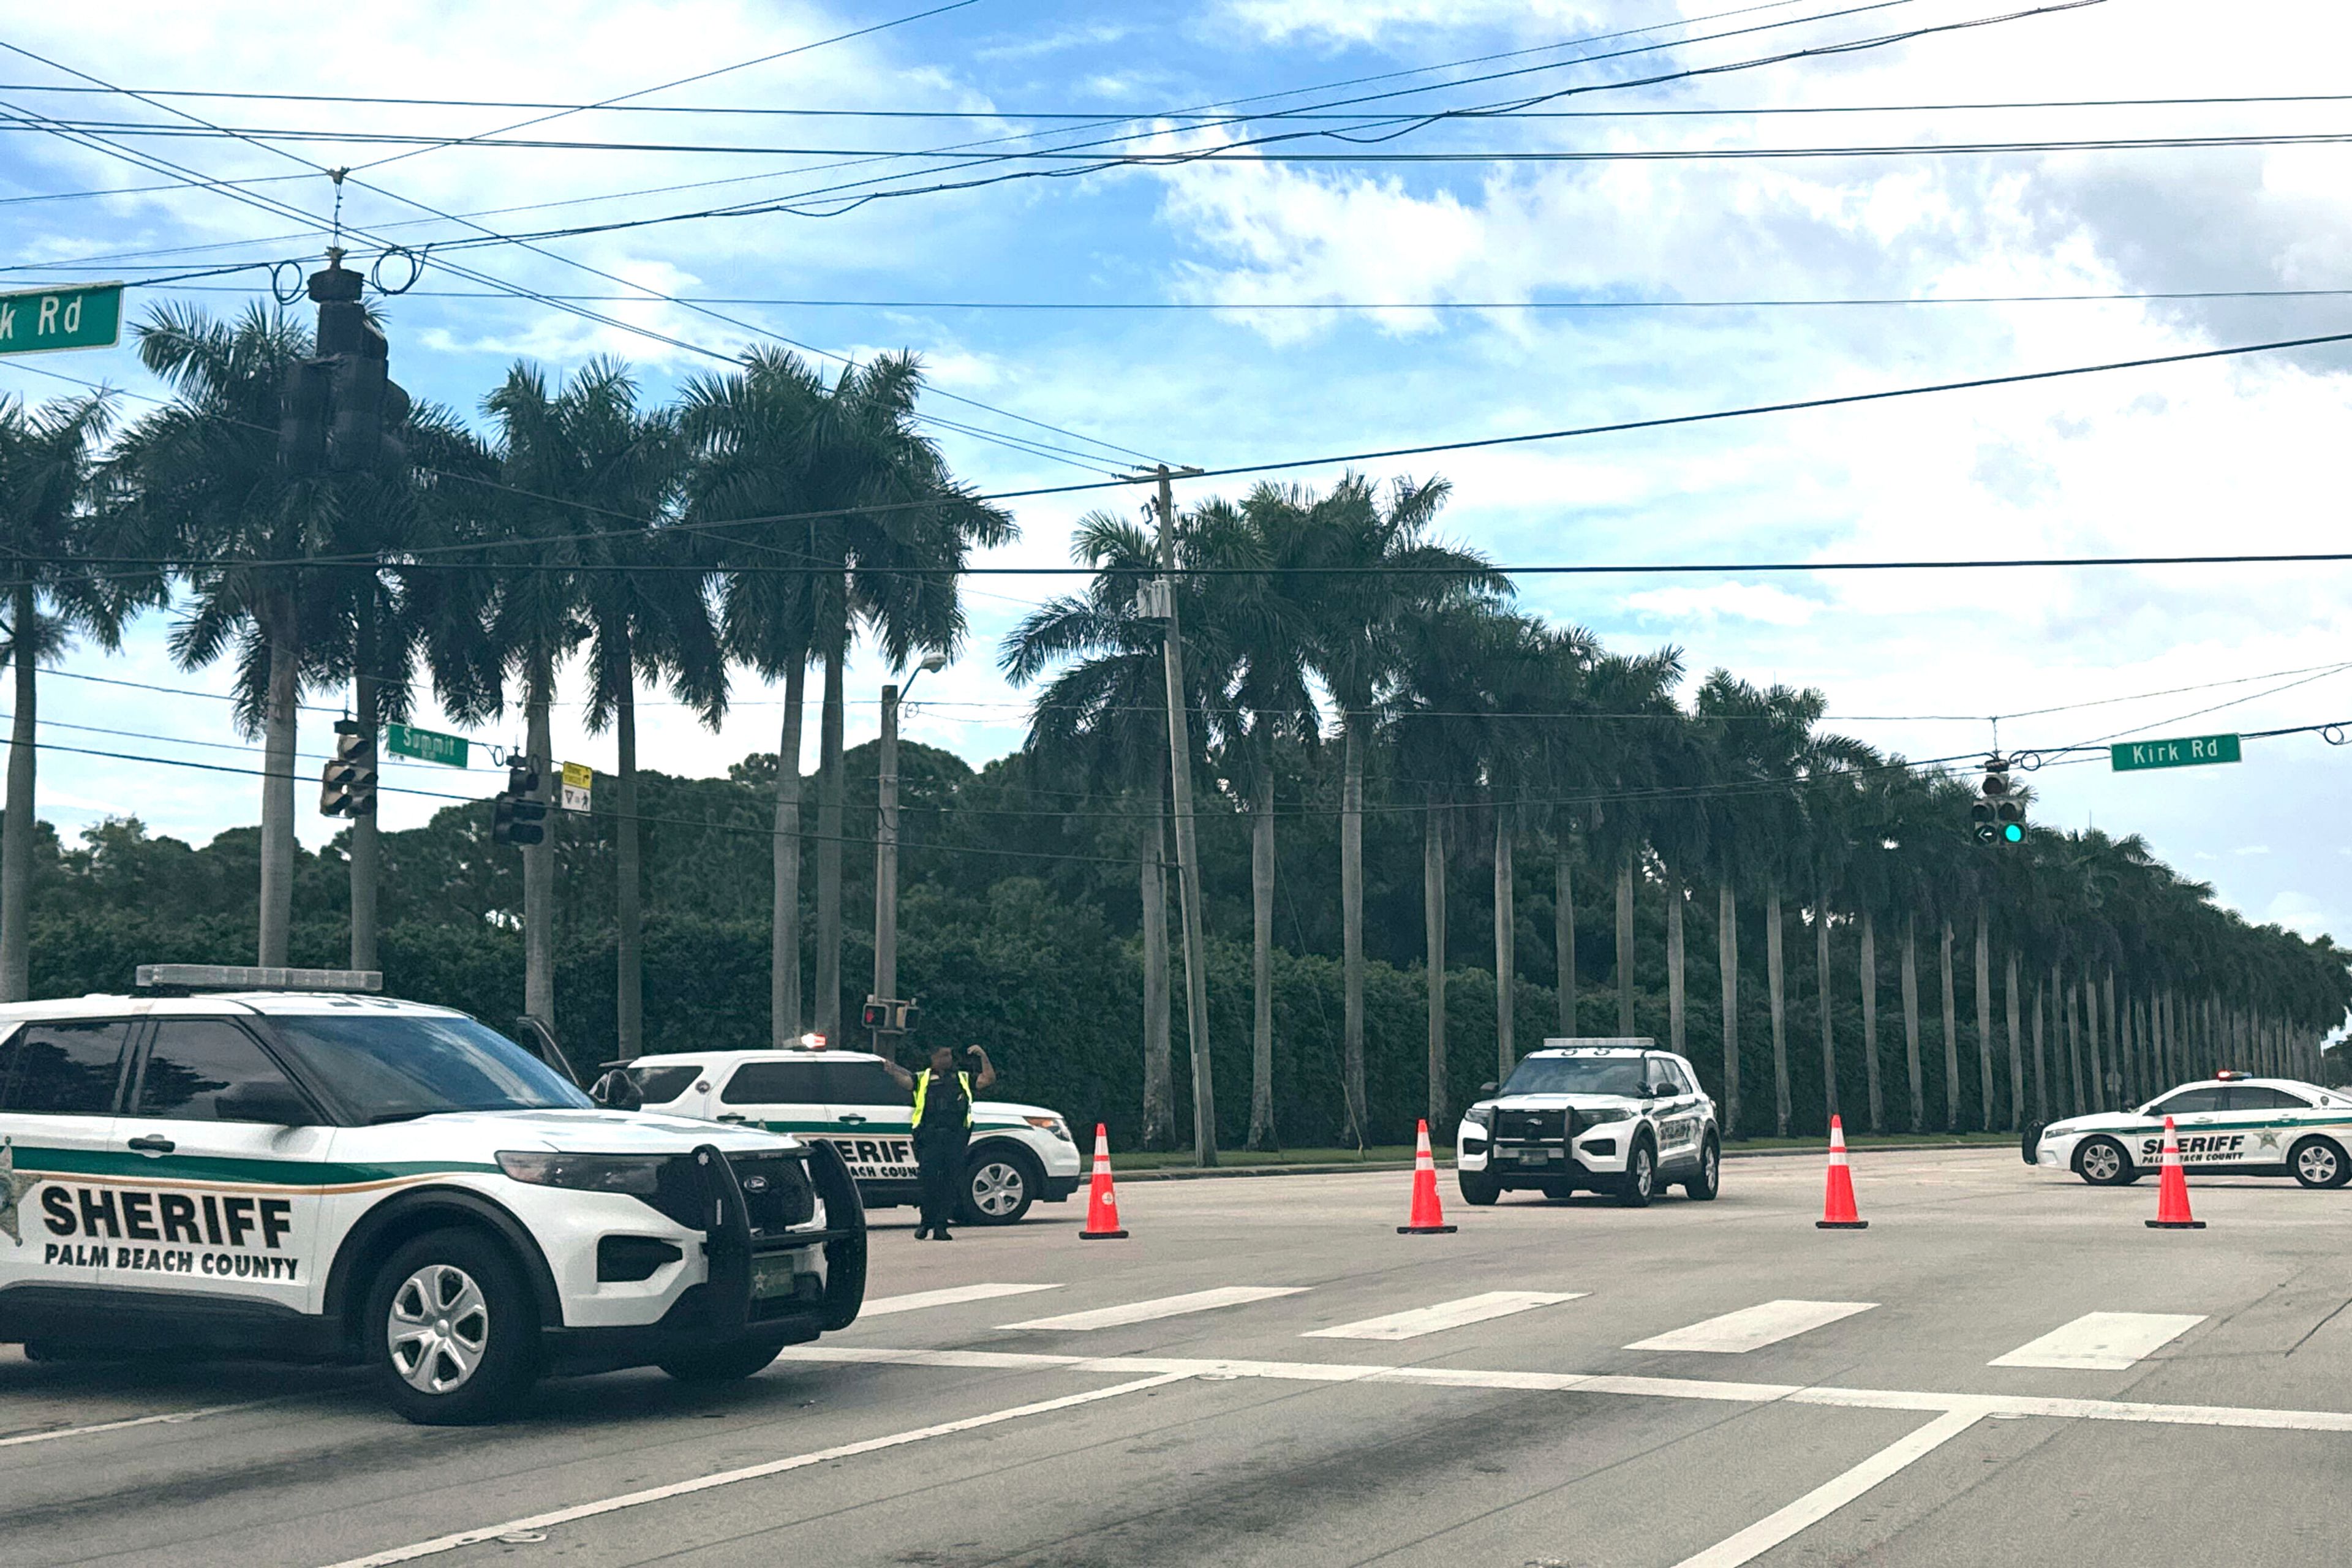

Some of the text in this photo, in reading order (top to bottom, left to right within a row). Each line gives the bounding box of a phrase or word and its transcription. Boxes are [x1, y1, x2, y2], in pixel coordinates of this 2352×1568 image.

[38, 295, 82, 336] Rd
[403, 728, 454, 756] Summit
[2133, 739, 2218, 764] Kirk Rd
[41, 1186, 292, 1249] SHERIFF
[45, 1243, 298, 1280] PALM BEACH COUNTY
